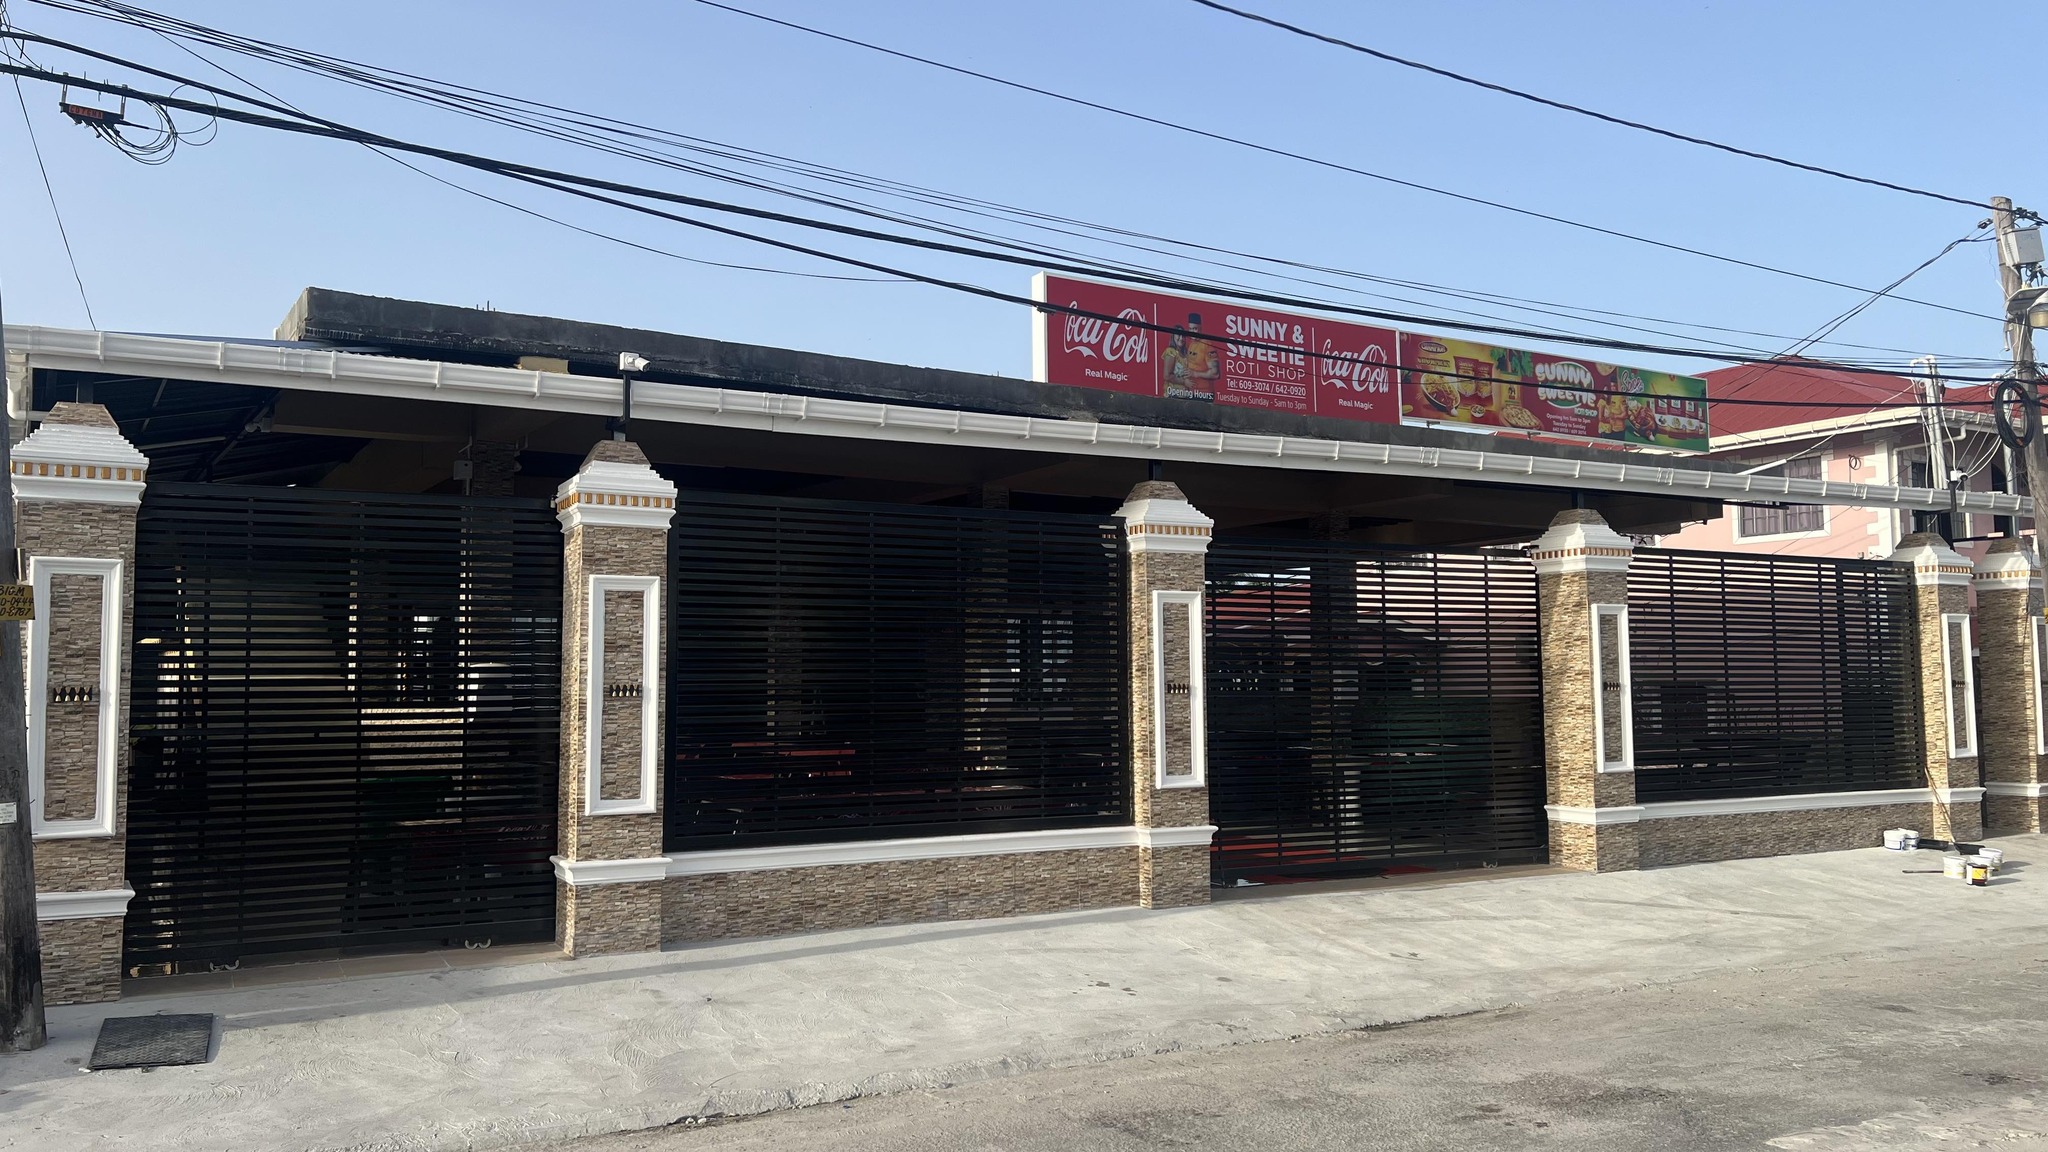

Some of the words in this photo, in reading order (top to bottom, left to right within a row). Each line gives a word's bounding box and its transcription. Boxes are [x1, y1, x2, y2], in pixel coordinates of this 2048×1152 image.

[1063, 300, 1149, 363] Coca-Cola
[1225, 314, 1288, 341] SUNNY
[1292, 325, 1304, 344] &
[1226, 337, 1305, 366] SWEETIE
[1085, 368, 1103, 378] Real
[1104, 371, 1128, 382] Magic
[1226, 359, 1260, 376] ROTI
[1268, 364, 1306, 381] SHOP
[1320, 338, 1389, 393] CocaCola
[1535, 362, 1592, 388] SUNNY
[1167, 386, 1194, 399] Opening
[1194, 389, 1214, 400] Hours:
[1226, 379, 1238, 389] Tel:
[1239, 380, 1270, 392] 609-3074
[1275, 385, 1307, 396] 642-0920
[1537, 384, 1597, 407] SWEETIE
[1217, 392, 1240, 404] Tuesday
[1241, 395, 1248, 404] to
[1248, 396, 1270, 407] Sunday
[1287, 399, 1294, 409] to
[1294, 401, 1307, 410] 3pm
[1338, 399, 1353, 408] Real
[1354, 401, 1374, 411] Magic
[1546, 413, 1562, 421] Opening
[1585, 409, 1598, 417] SHOP
